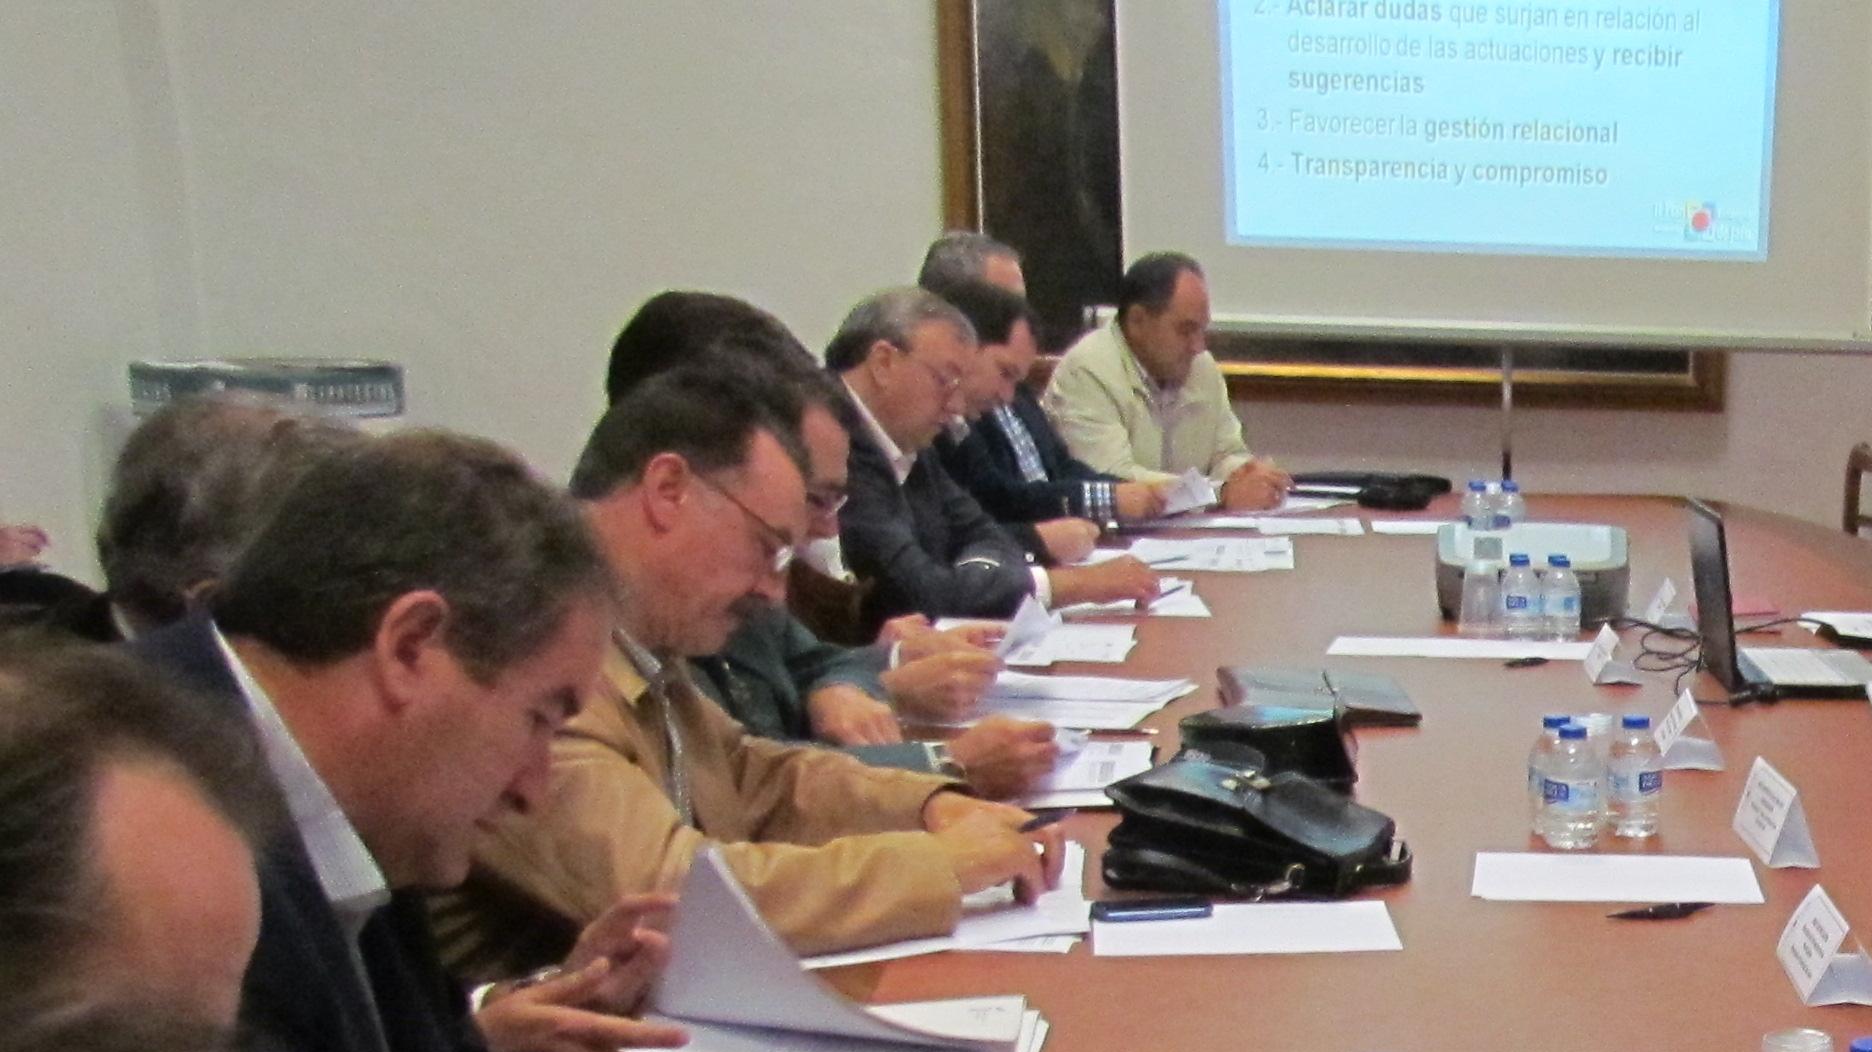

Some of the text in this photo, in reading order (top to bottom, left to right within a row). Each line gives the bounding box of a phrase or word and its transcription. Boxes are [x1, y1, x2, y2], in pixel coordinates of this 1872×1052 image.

[1287, 0, 1369, 20] Aclarar
[1374, 0, 1442, 22] dudas
[1449, 5, 1488, 28] que
[1495, 5, 1558, 31] surjan
[1564, 10, 1588, 29] en
[1596, 8, 1678, 32] relación
[1683, 10, 1701, 33] al
[1288, 31, 1684, 70] desarrollo de las actuaciones y recibir
[1288, 69, 1426, 96] sugerencias
[1289, 108, 1397, 138] Favorecer
[1400, 114, 1418, 137] la
[1423, 116, 1505, 143] gestión
[1511, 120, 1619, 144] relacional
[1290, 152, 1448, 182] Transparencia
[1455, 162, 1467, 187] y
[1472, 162, 1609, 188] compromiso
